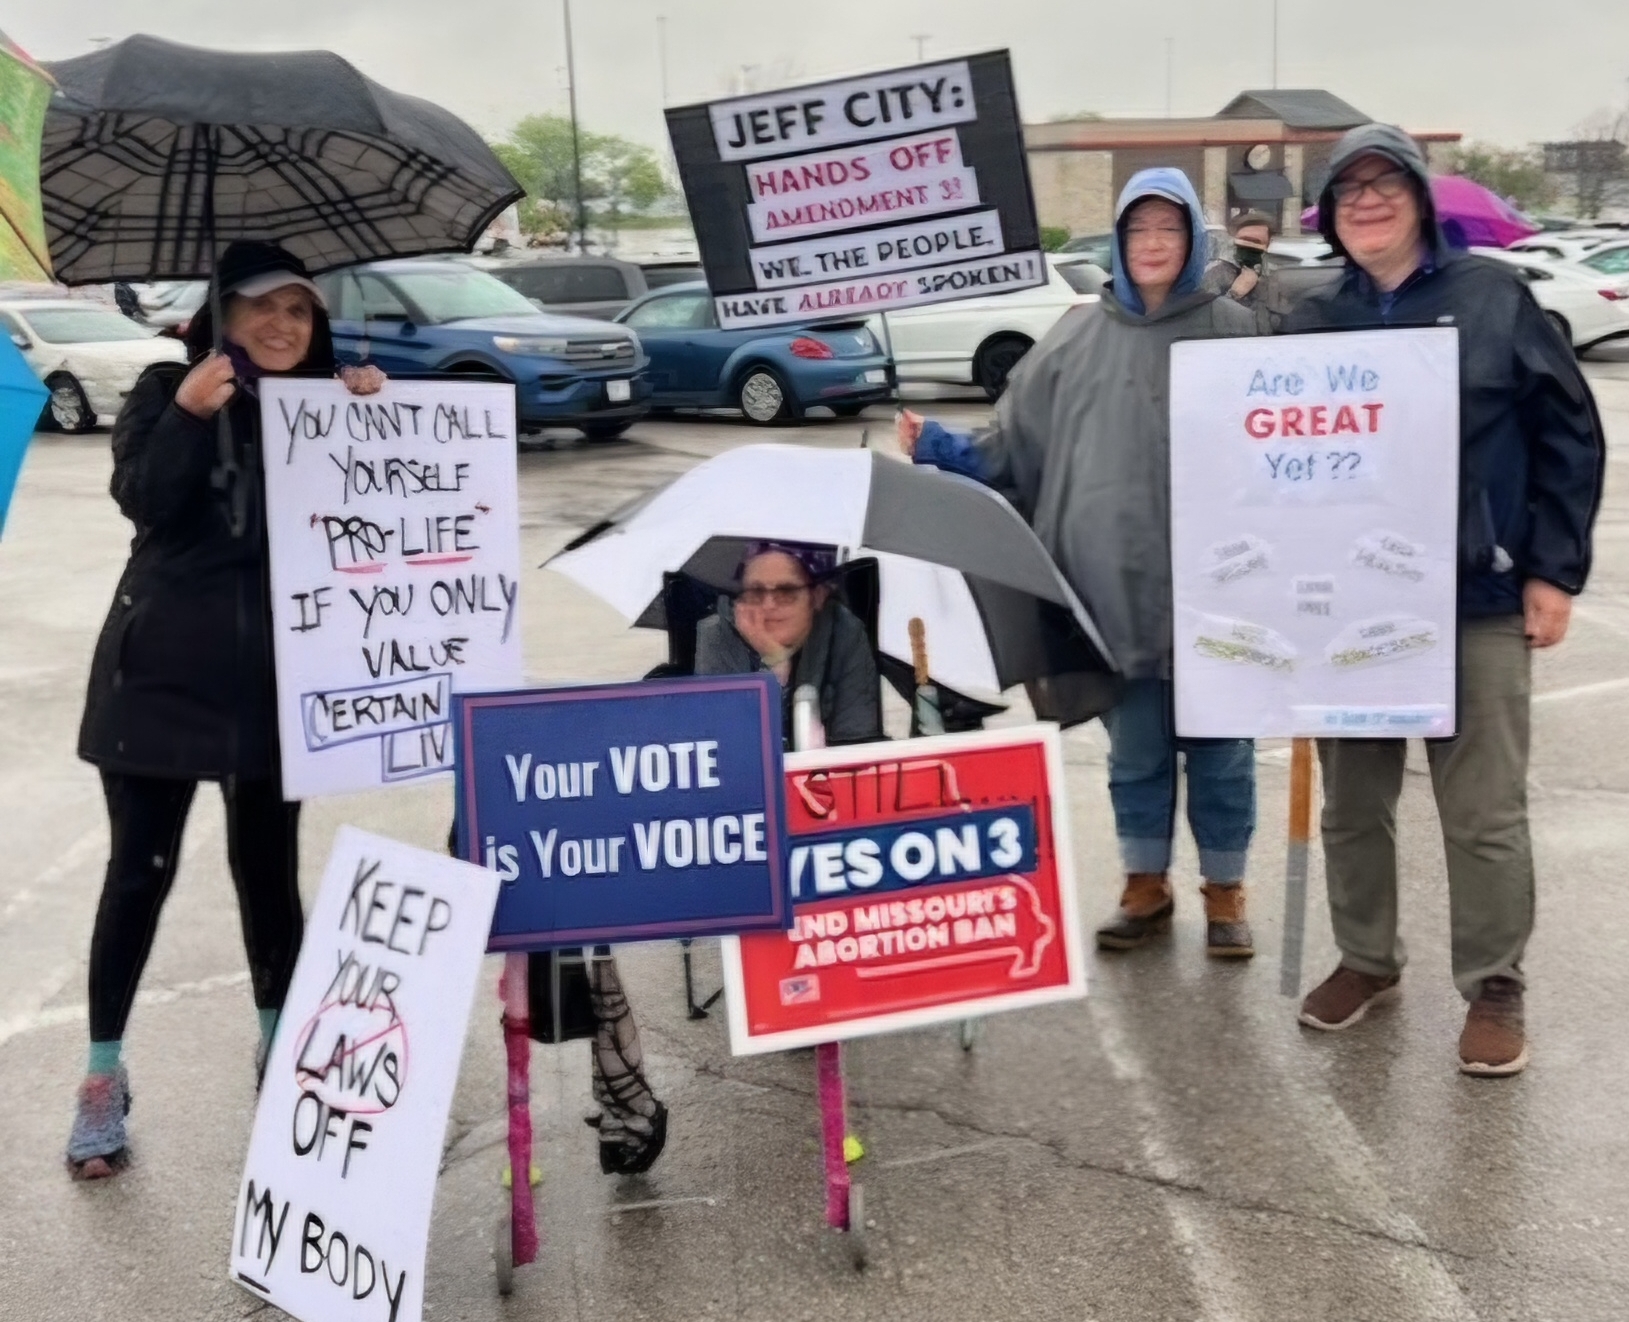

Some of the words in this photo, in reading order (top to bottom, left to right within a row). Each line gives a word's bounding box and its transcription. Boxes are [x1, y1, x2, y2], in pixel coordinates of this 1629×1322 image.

[728, 99, 825, 148] JEFF
[843, 76, 965, 128] CITY:
[753, 156, 871, 198] HANDS
[889, 137, 953, 173] OFF
[766, 184, 929, 230] AMENDMENT
[815, 246, 868, 272] THE
[723, 296, 788, 318] HAVE
[799, 280, 908, 312] ALREADY
[1246, 368, 1305, 397] Are
[1326, 364, 1380, 393] We
[278, 397, 336, 465] YOU
[434, 402, 507, 443] CALL
[1244, 402, 1384, 439] GREAT
[328, 445, 470, 505] YOURSELF
[290, 586, 333, 632] IF
[349, 583, 414, 639] YOU
[430, 574, 518, 645] ONLY
[361, 637, 470, 679] VALUE
[310, 680, 442, 743] CERTAIN
[505, 752, 600, 803] Your
[609, 740, 721, 795] VOTE
[486, 836, 520, 882] is
[530, 828, 626, 879] Your
[632, 812, 768, 871] VOICE
[890, 823, 982, 882] ON
[987, 816, 1023, 868] 3
[339, 857, 452, 956] KEEP
[853, 885, 1018, 933] MISSOURI'S
[793, 922, 949, 970] ABORTION
[953, 912, 1017, 945] BAN
[320, 948, 402, 1025] YOUR
[296, 1018, 400, 1108] LAWS
[293, 1090, 372, 1180] OFF
[240, 1178, 291, 1278] MY
[301, 1211, 406, 1322] BODY
